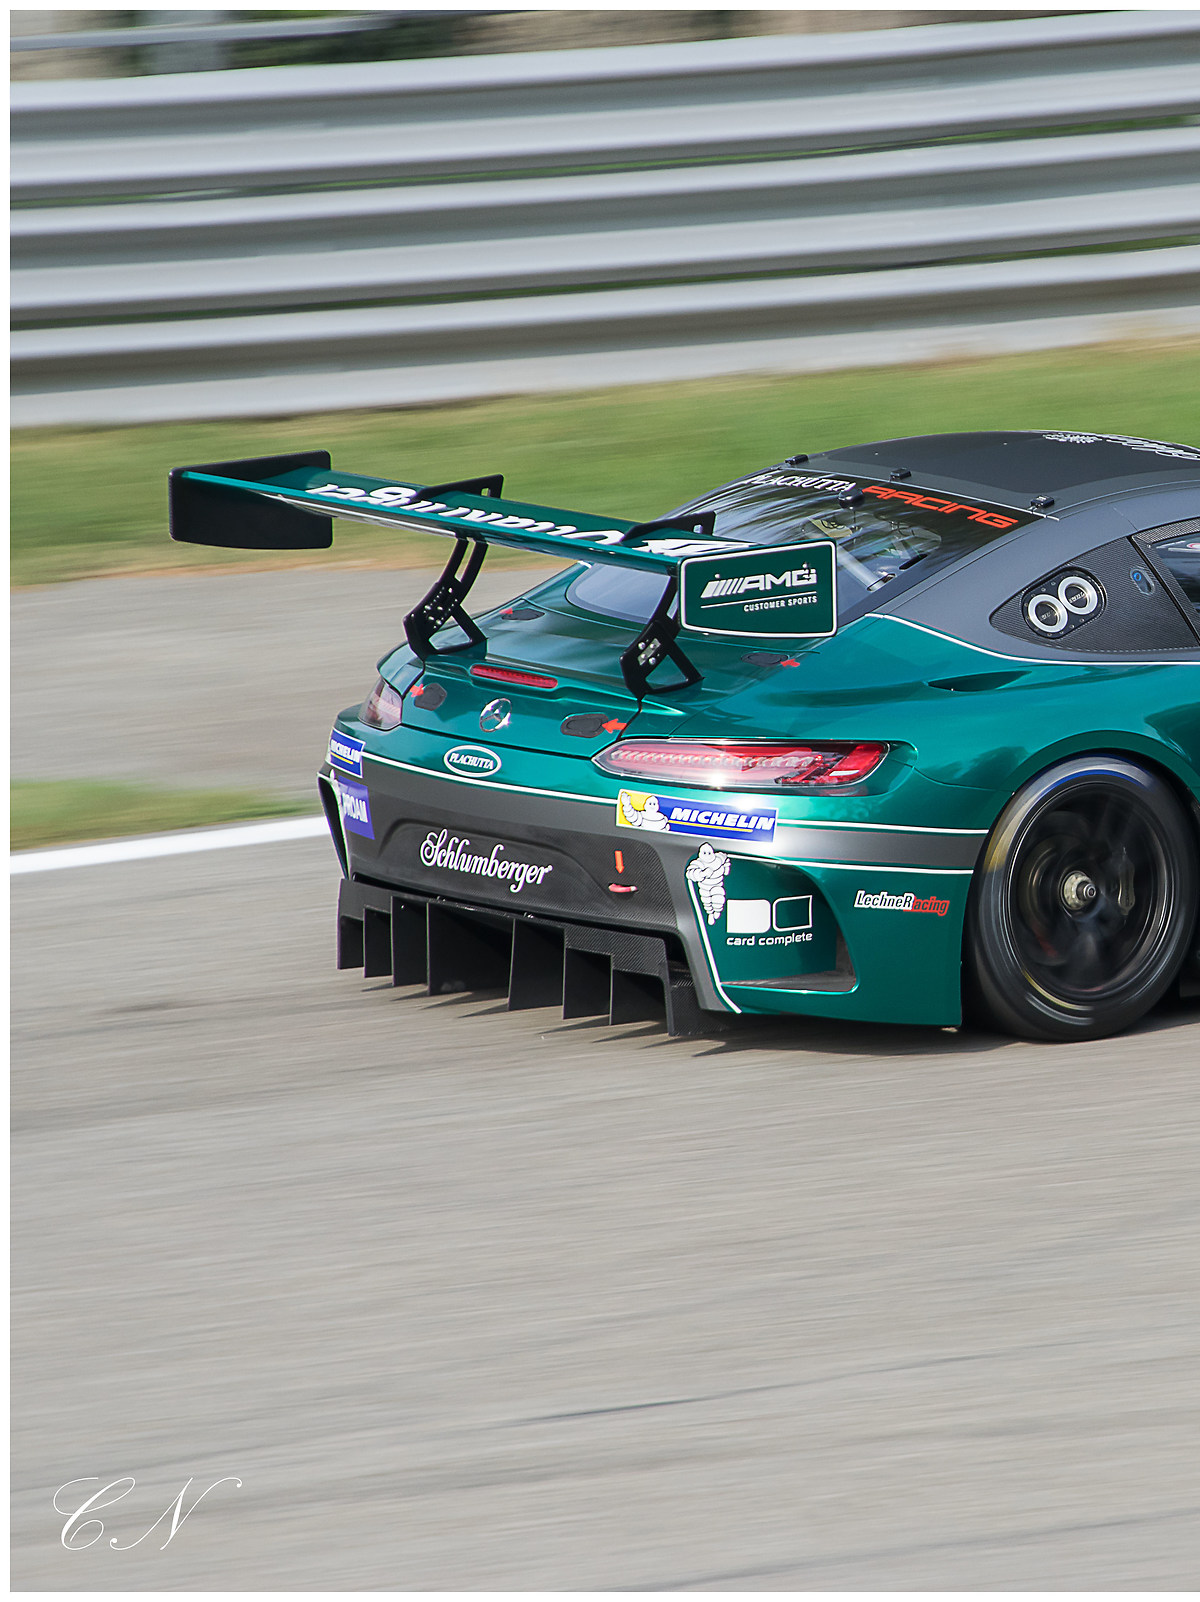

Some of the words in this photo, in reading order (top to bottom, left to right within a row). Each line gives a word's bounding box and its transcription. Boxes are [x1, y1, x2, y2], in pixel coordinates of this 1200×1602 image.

[862, 485, 1019, 529] RACING
[737, 568, 818, 594] AMG
[744, 598, 786, 612] CUSTOMER
[788, 595, 818, 607] SPORTS
[448, 752, 495, 770] PLACHUTTA
[670, 806, 776, 832] MICHELIN
[420, 828, 554, 893] Schlumberger
[726, 935, 755, 947] card
[758, 931, 813, 947] complete
